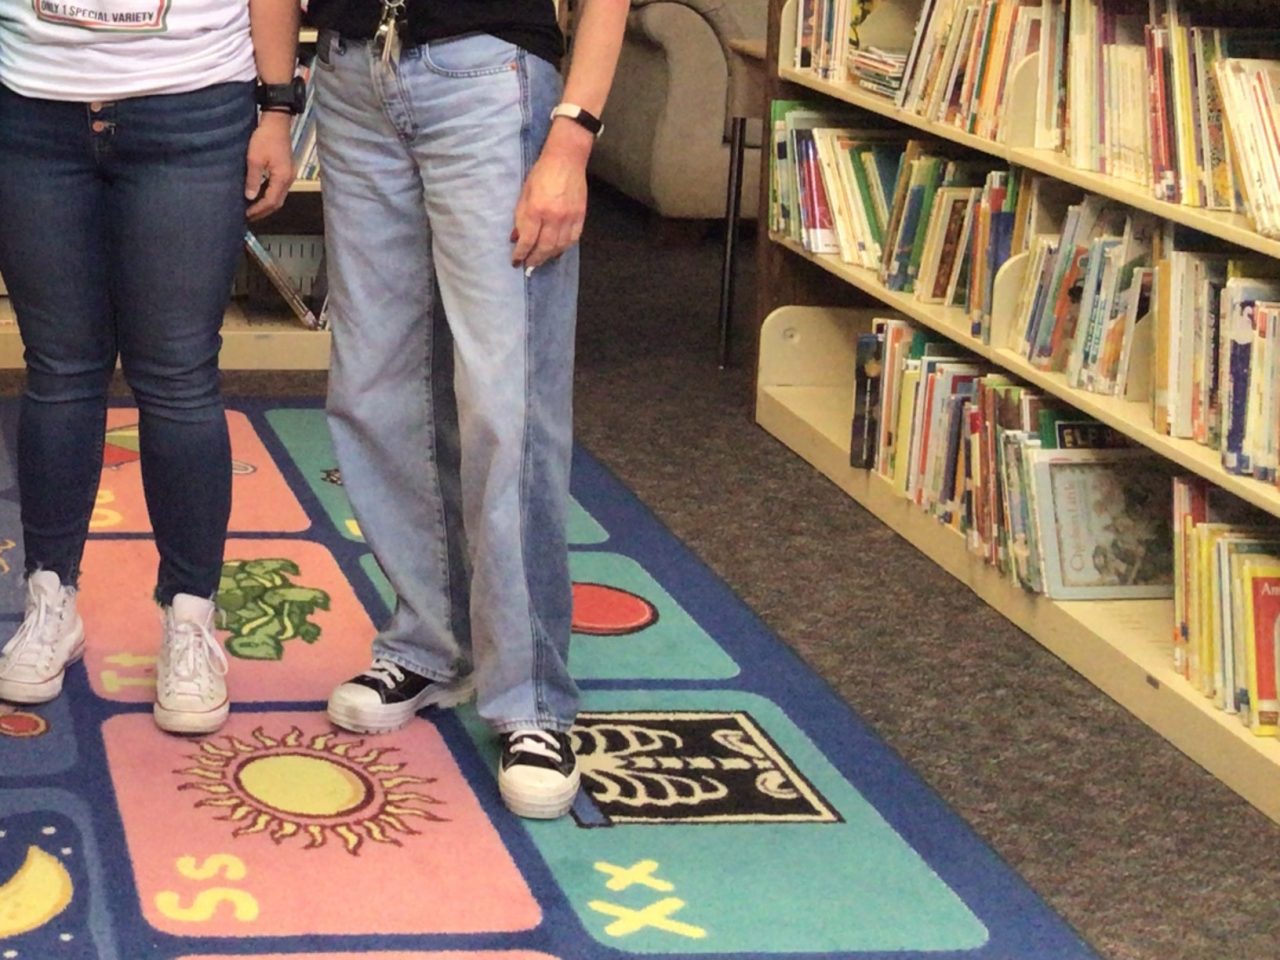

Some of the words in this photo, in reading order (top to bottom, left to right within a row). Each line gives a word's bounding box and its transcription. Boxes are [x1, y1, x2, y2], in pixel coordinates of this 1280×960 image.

[69, 5, 110, 23] SPECIAL
[112, 11, 154, 23] VARIETY
[154, 852, 260, 923] Ss
